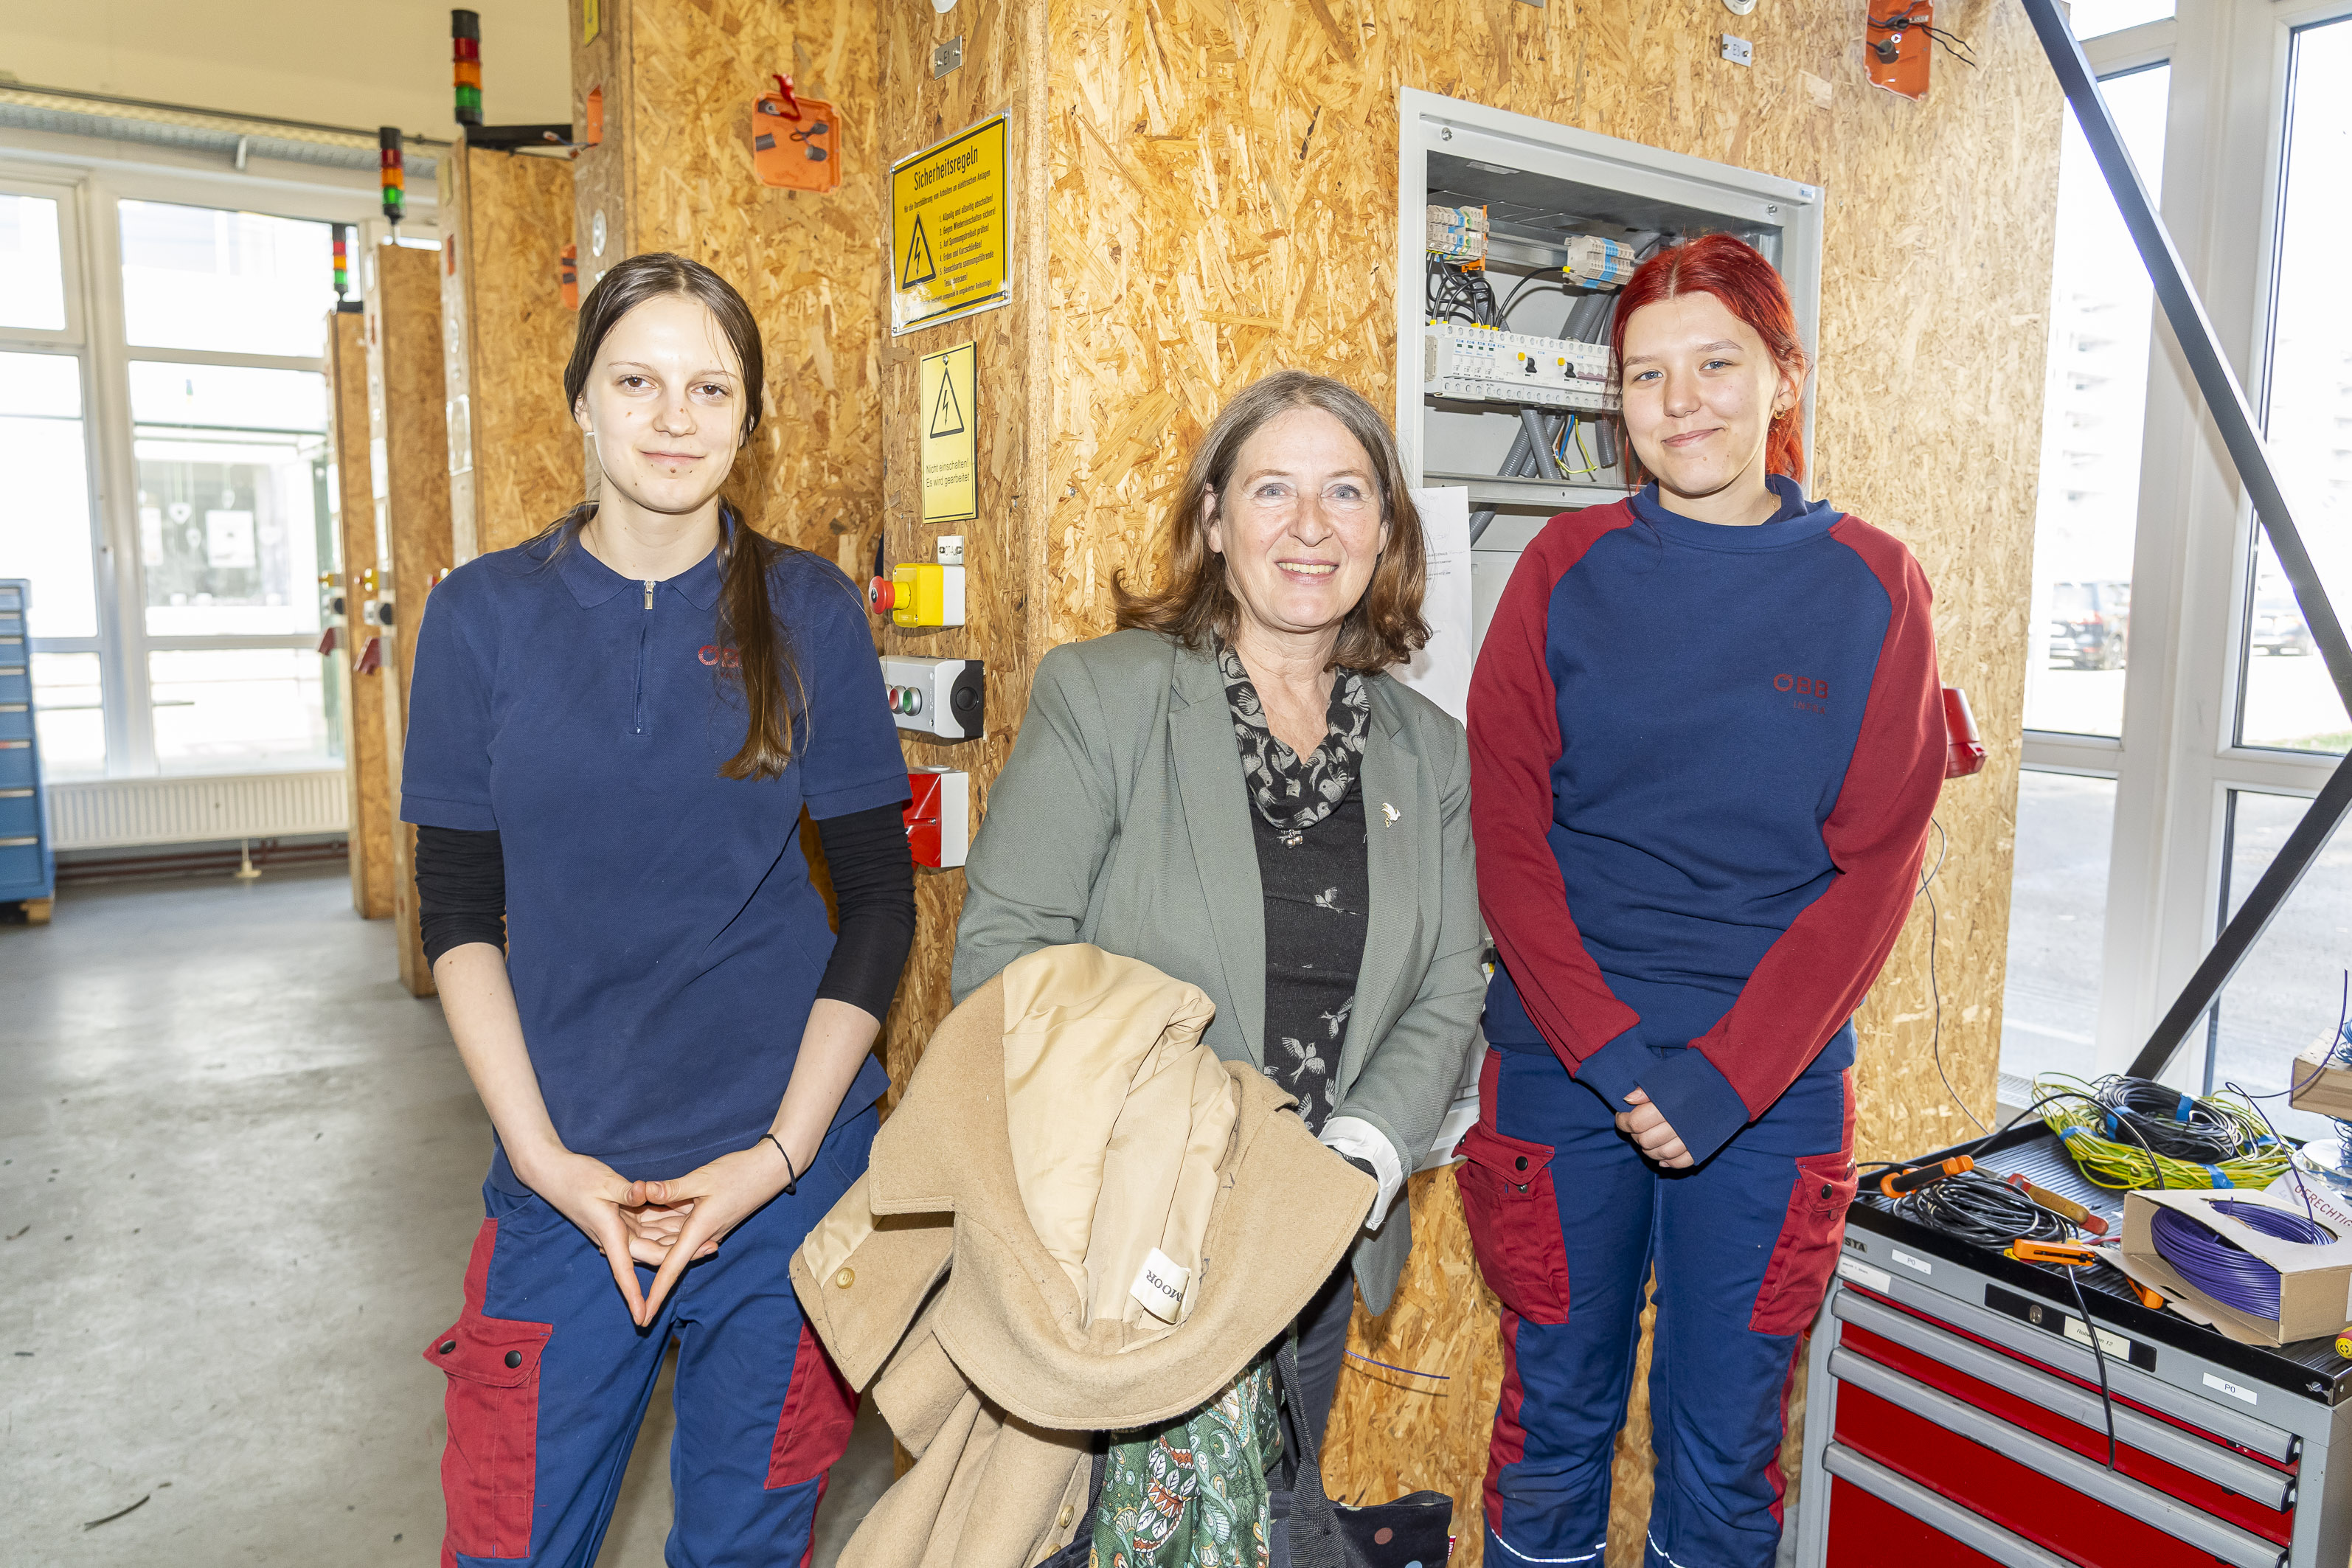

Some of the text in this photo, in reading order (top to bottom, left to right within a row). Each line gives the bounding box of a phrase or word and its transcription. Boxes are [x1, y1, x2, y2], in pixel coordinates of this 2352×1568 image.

[943, 49, 950, 65] E1
[914, 145, 978, 191] Sicherheitsregeln
[939, 187, 952, 198] Arbeiten
[957, 176, 976, 190] elektrischen
[977, 170, 991, 181] Anlagen
[943, 211, 954, 222] Allpolig
[961, 202, 974, 214] allseitig
[974, 192, 993, 209] abschalten!
[943, 225, 953, 235] Gegen
[953, 213, 982, 231] Wiedereinschalten
[982, 206, 996, 219] sichern!
[949, 228, 976, 247] Spannungsfreiheit
[943, 251, 952, 261] Erden
[943, 262, 962, 274] Benachbarte
[962, 250, 994, 268] spannungsführende
[926, 457, 969, 474] Nicht einschalten!
[926, 472, 970, 488] Es wird gearbeitet
[1793, 700, 1826, 715] INFRA
[1845, 1237, 1867, 1252] STA
[1145, 1269, 1183, 1303] MOOR
